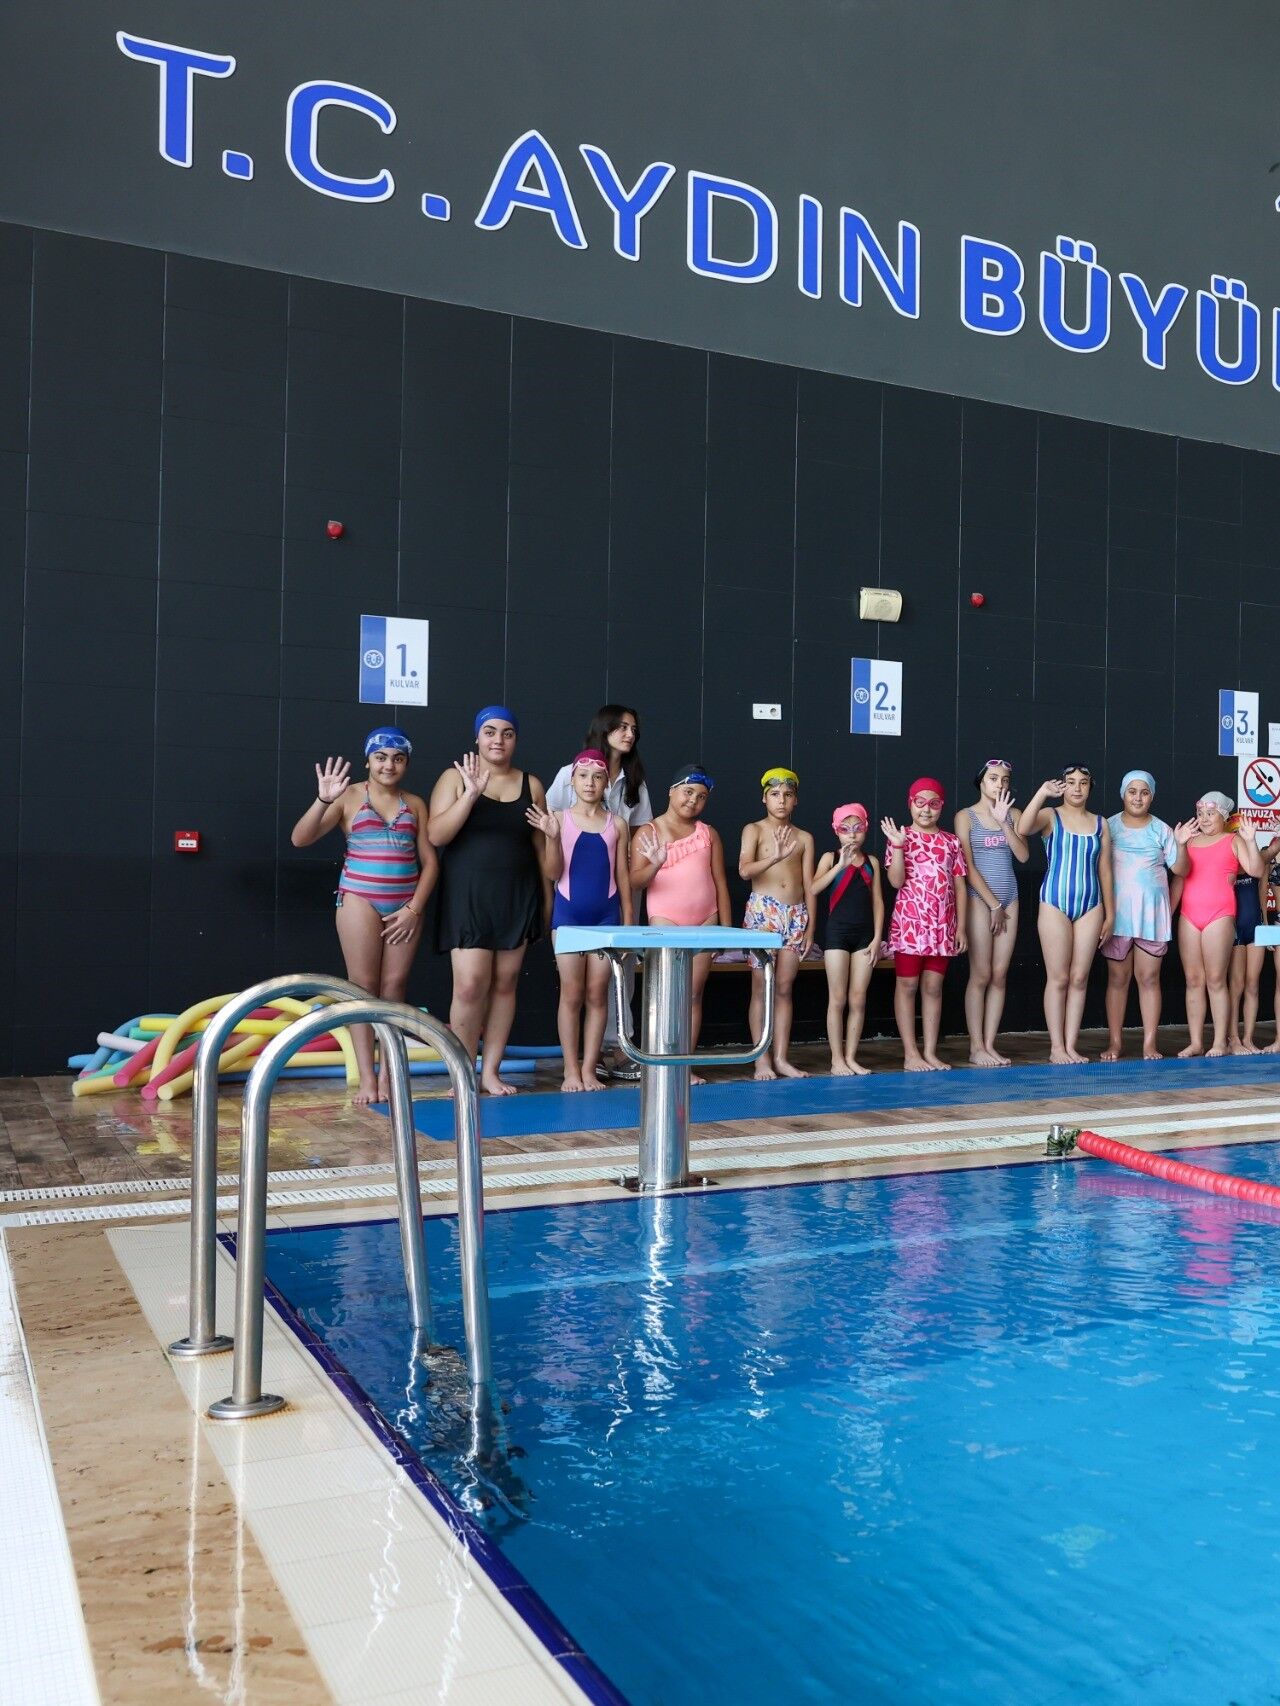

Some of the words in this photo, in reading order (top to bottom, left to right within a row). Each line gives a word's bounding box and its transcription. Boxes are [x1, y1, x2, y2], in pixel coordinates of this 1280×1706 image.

[475, 130, 920, 319] AYDIN
[396, 643, 417, 677] 1.
[390, 679, 420, 689] KULVAR
[875, 681, 896, 711] 2.
[1236, 709, 1254, 736] 3.
